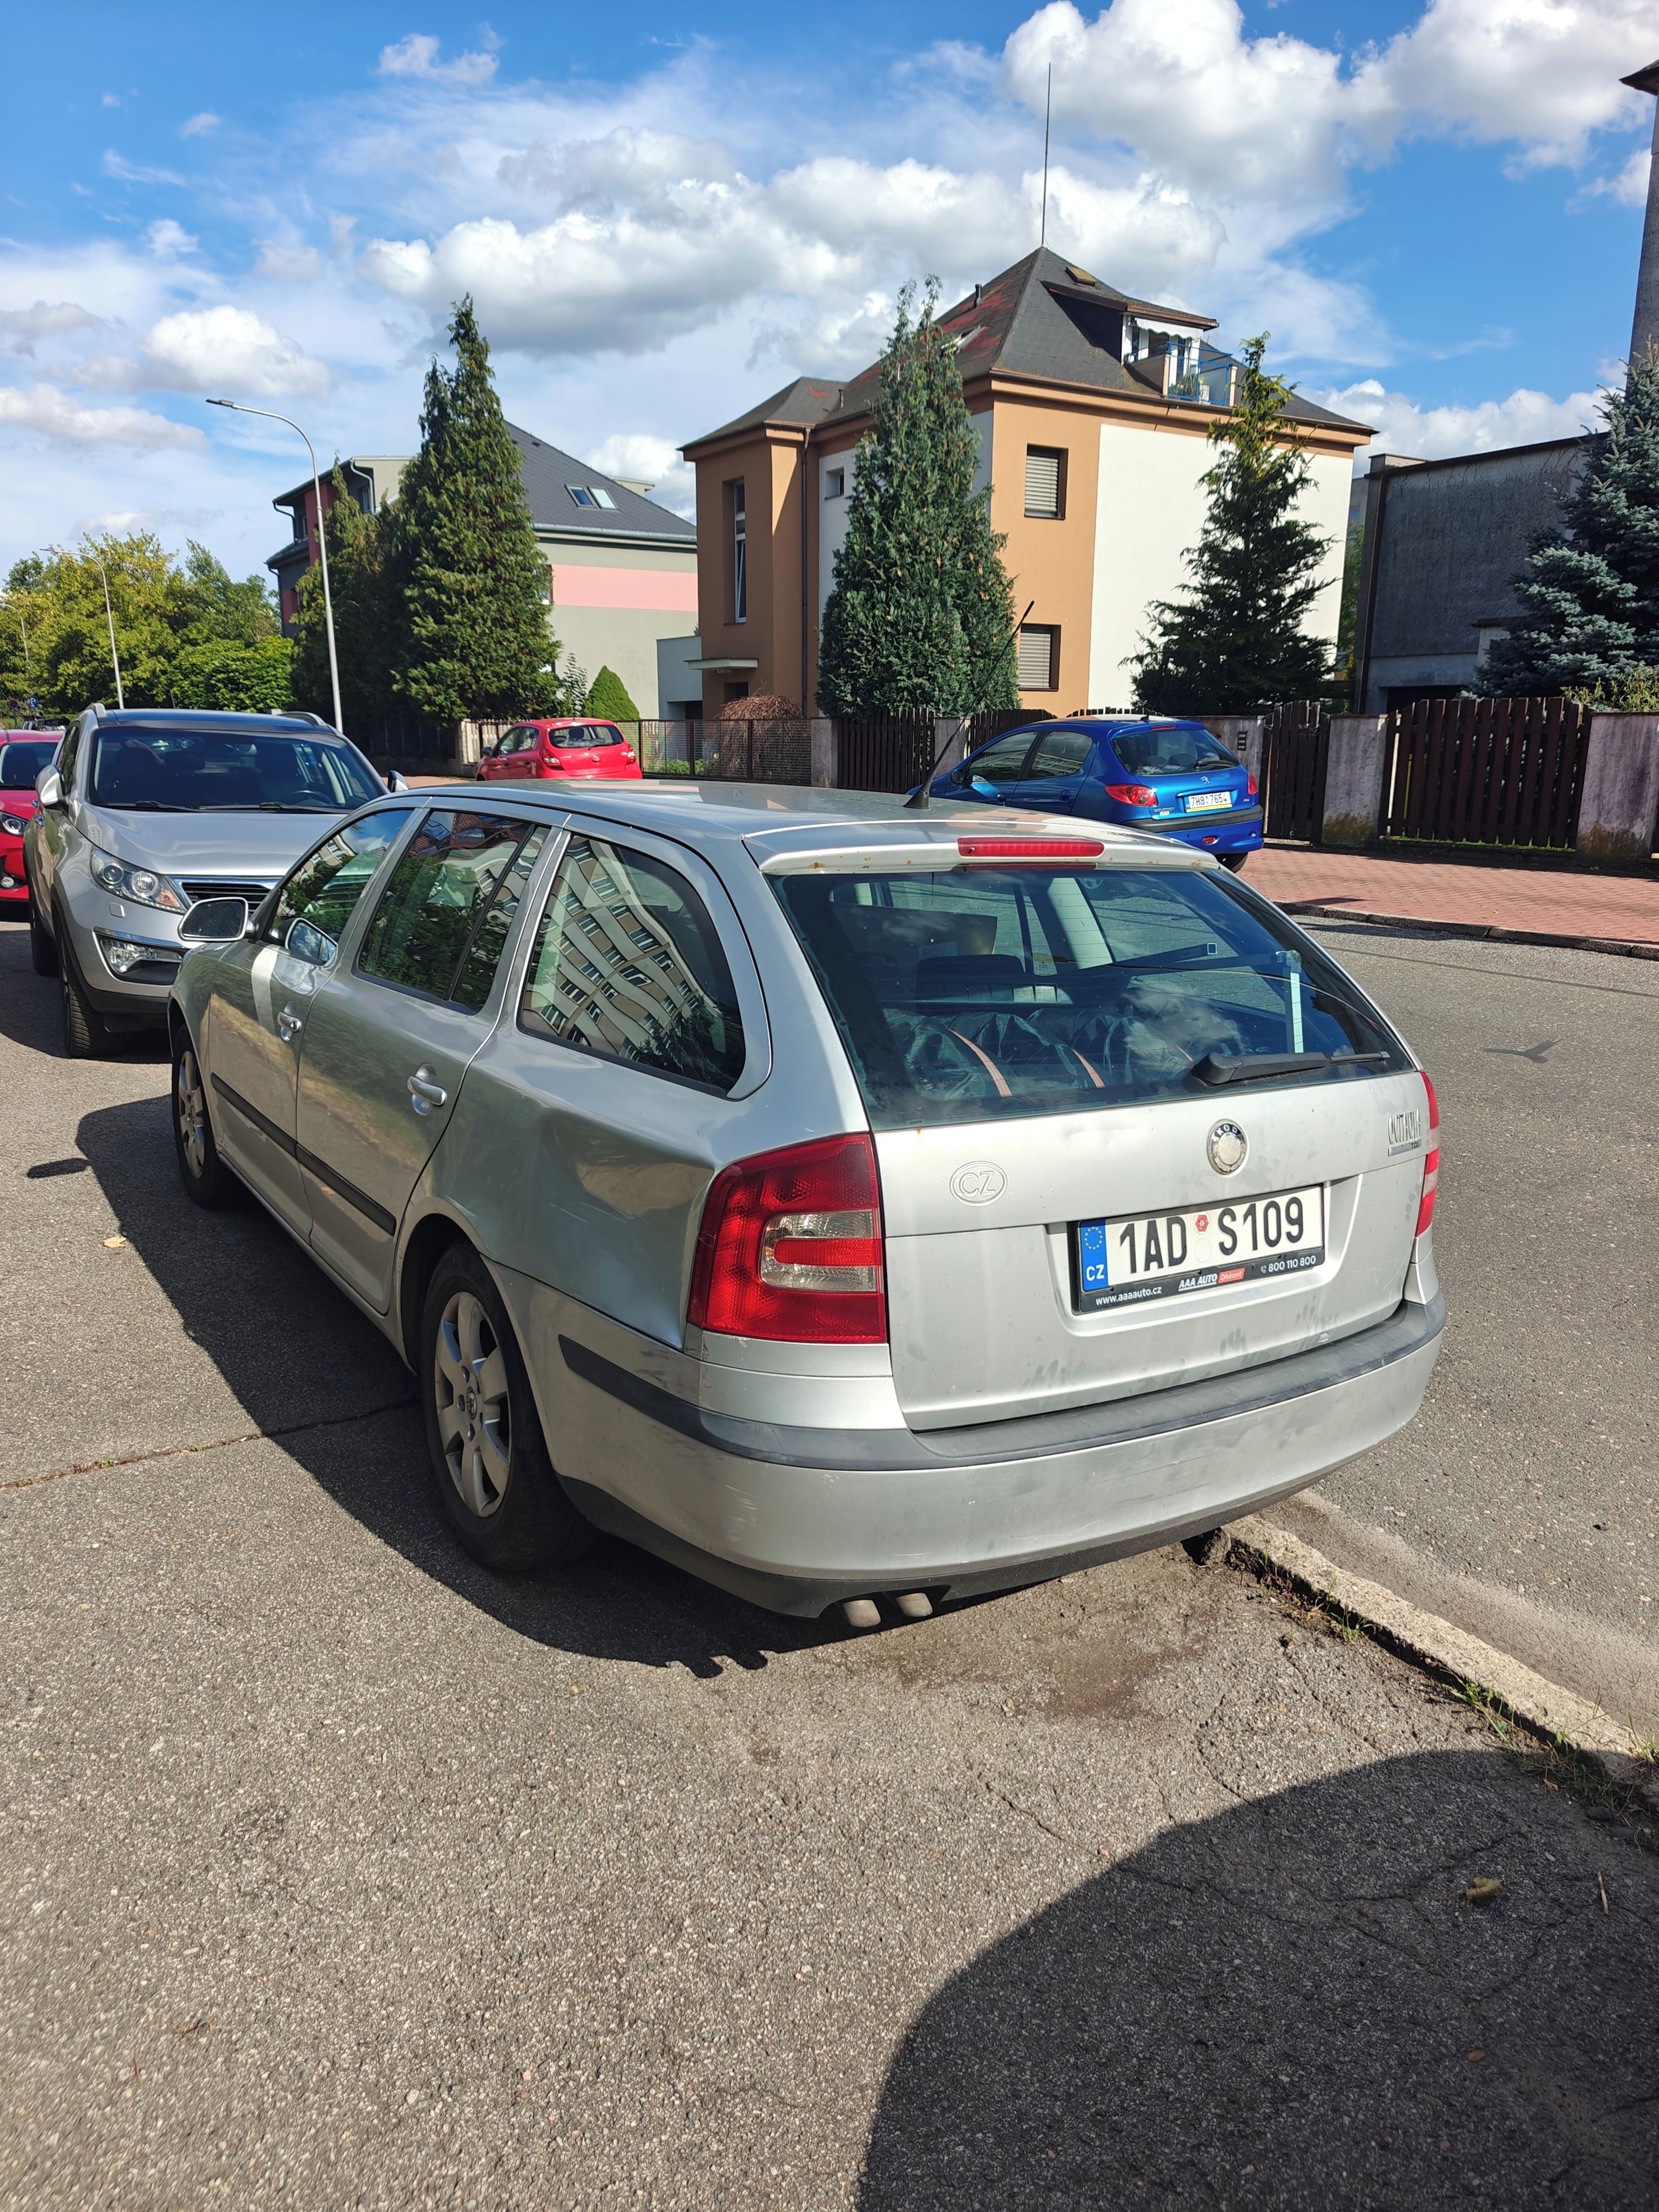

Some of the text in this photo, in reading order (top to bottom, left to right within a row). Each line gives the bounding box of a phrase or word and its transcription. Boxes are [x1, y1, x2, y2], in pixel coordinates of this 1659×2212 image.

[1191, 793, 1227, 806] 7H8 7654
[959, 1170, 996, 1197] CZ
[1120, 1196, 1304, 1274] 1AD S109
[1268, 1255, 1316, 1272] 800 110 800
[1086, 1264, 1105, 1282] CZ
[1179, 1271, 1243, 1289] AAA AUTO Diskont
[1095, 1286, 1162, 1306] www.aaaauto.cz
